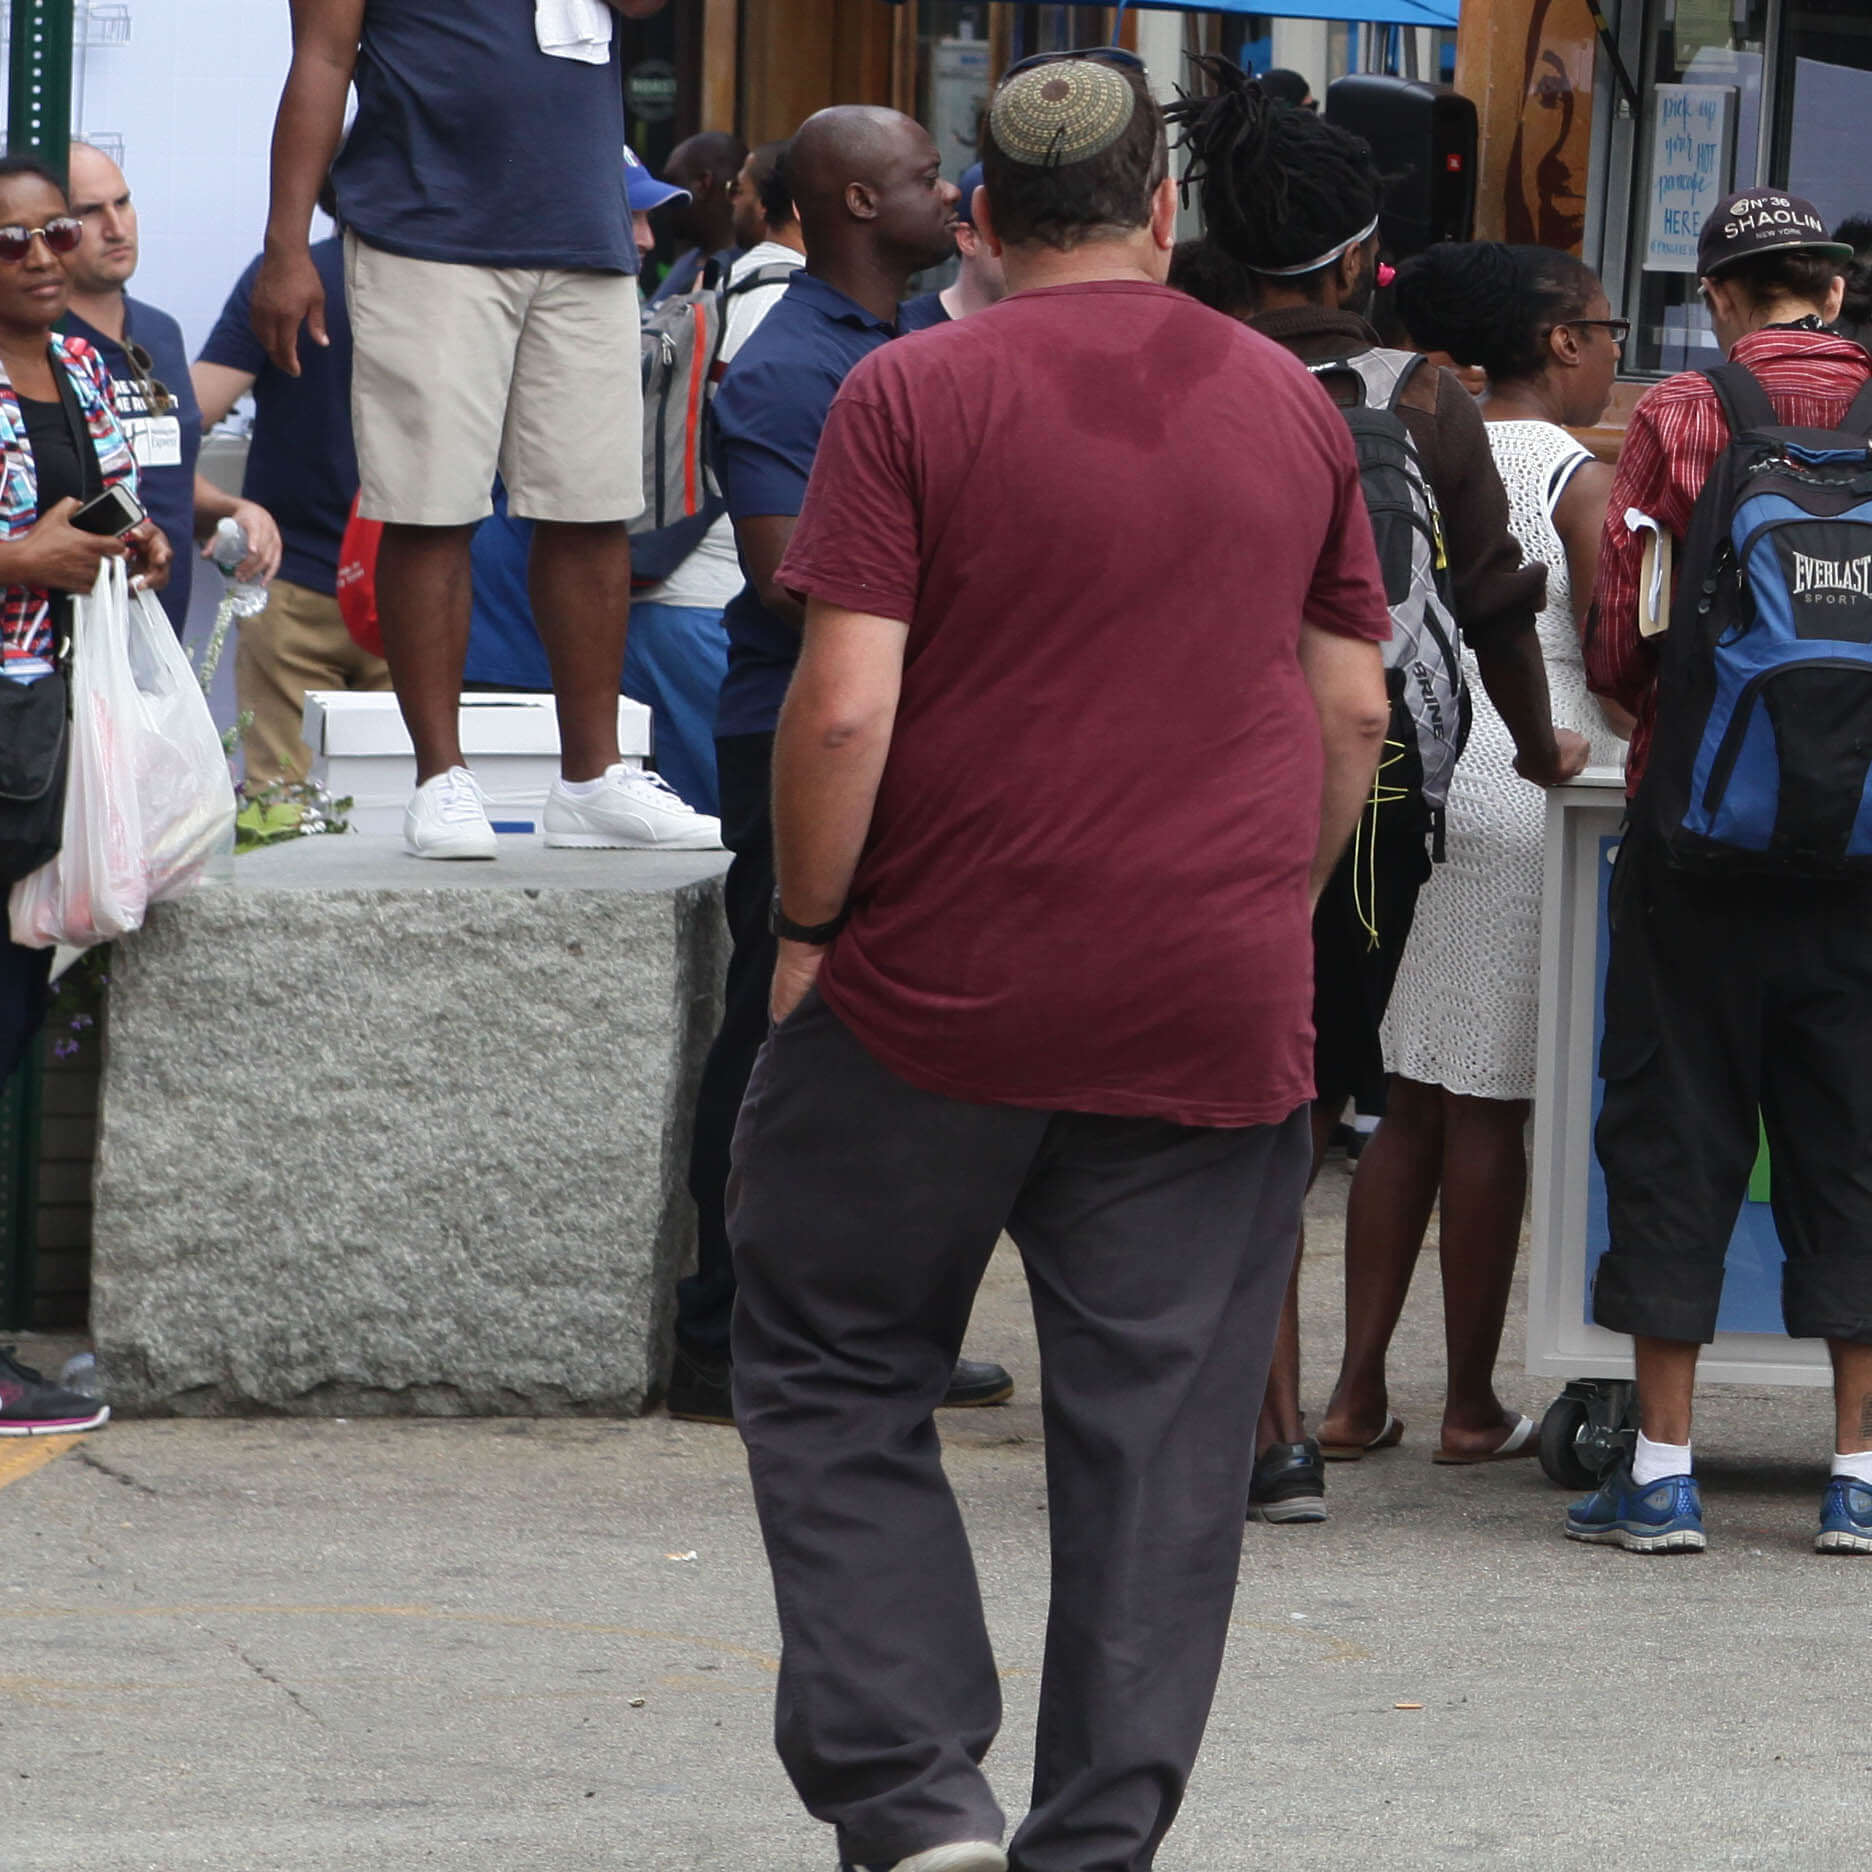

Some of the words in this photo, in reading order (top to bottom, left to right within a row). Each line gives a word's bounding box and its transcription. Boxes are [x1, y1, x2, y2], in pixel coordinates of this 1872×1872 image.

[1770, 196, 1791, 209] 36
[1664, 207, 1700, 238] HERE
[1723, 209, 1823, 240] SHAOLIN
[1755, 230, 1775, 240] NEW
[1777, 228, 1803, 238] YORK
[1791, 550, 1872, 597] EVERLAST
[1804, 593, 1858, 605] SPORT
[1413, 659, 1445, 742] BRINE
